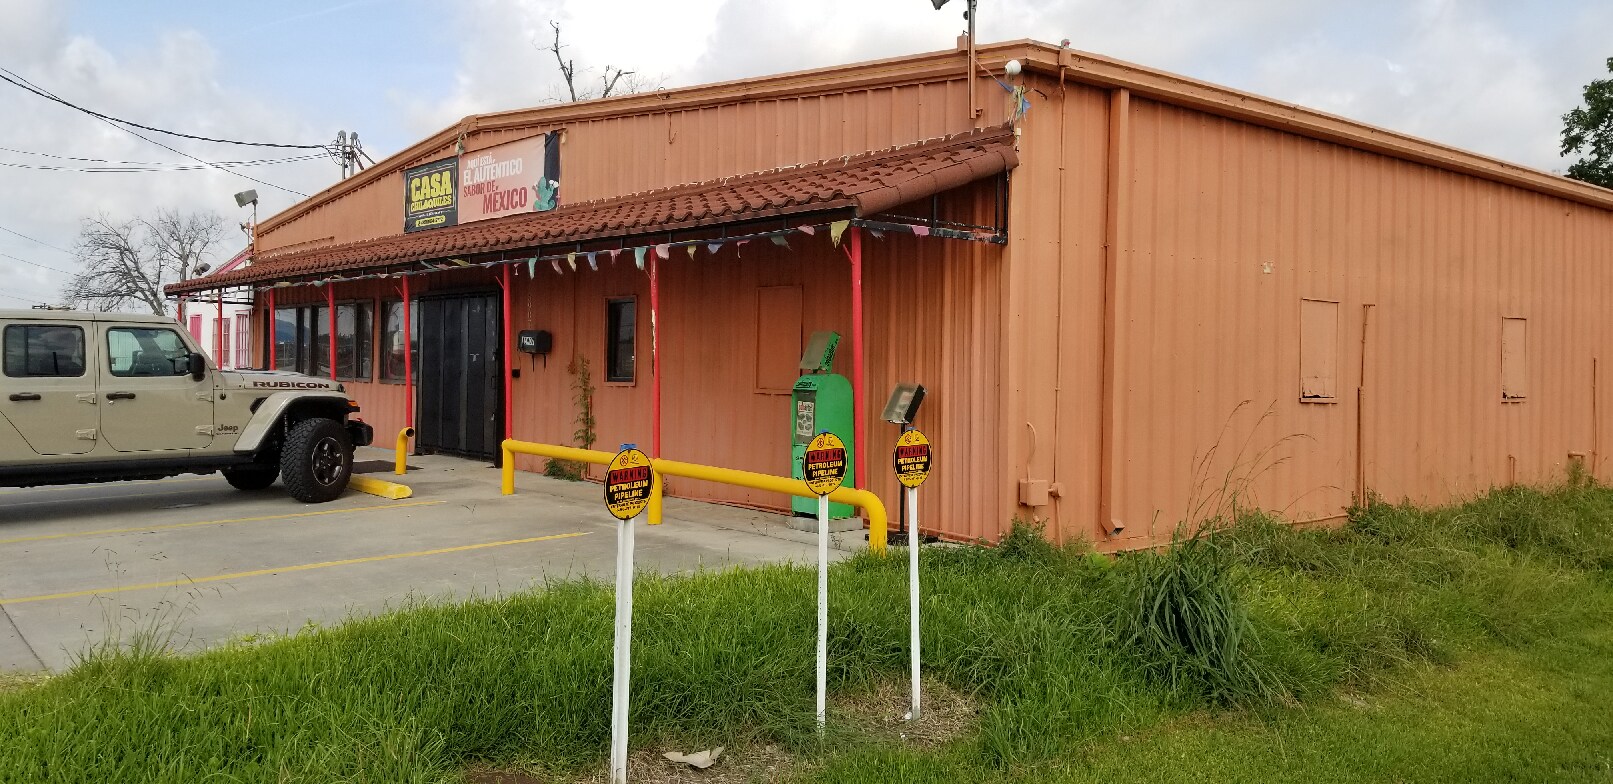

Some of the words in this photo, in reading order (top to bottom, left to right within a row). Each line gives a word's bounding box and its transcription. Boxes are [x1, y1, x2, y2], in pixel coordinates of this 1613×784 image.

[464, 169, 472, 186] EL
[411, 171, 452, 202] CASA
[464, 182, 485, 198] SABOR
[487, 180, 496, 193] DE
[411, 195, 452, 212] CHILAQUILES
[253, 381, 330, 389] RUBICON
[217, 424, 238, 432] Jeep
[811, 449, 841, 461] WARNING
[899, 446, 927, 456] WARNING
[808, 460, 842, 470] PETROLEUM
[898, 456, 927, 464] PETROLEUM
[812, 468, 838, 477] PIPELINE
[902, 463, 924, 472] PIPELINE
[612, 468, 648, 481] WARNING
[610, 480, 649, 492] PETROLEUM
[614, 489, 643, 500] PIPELINE
